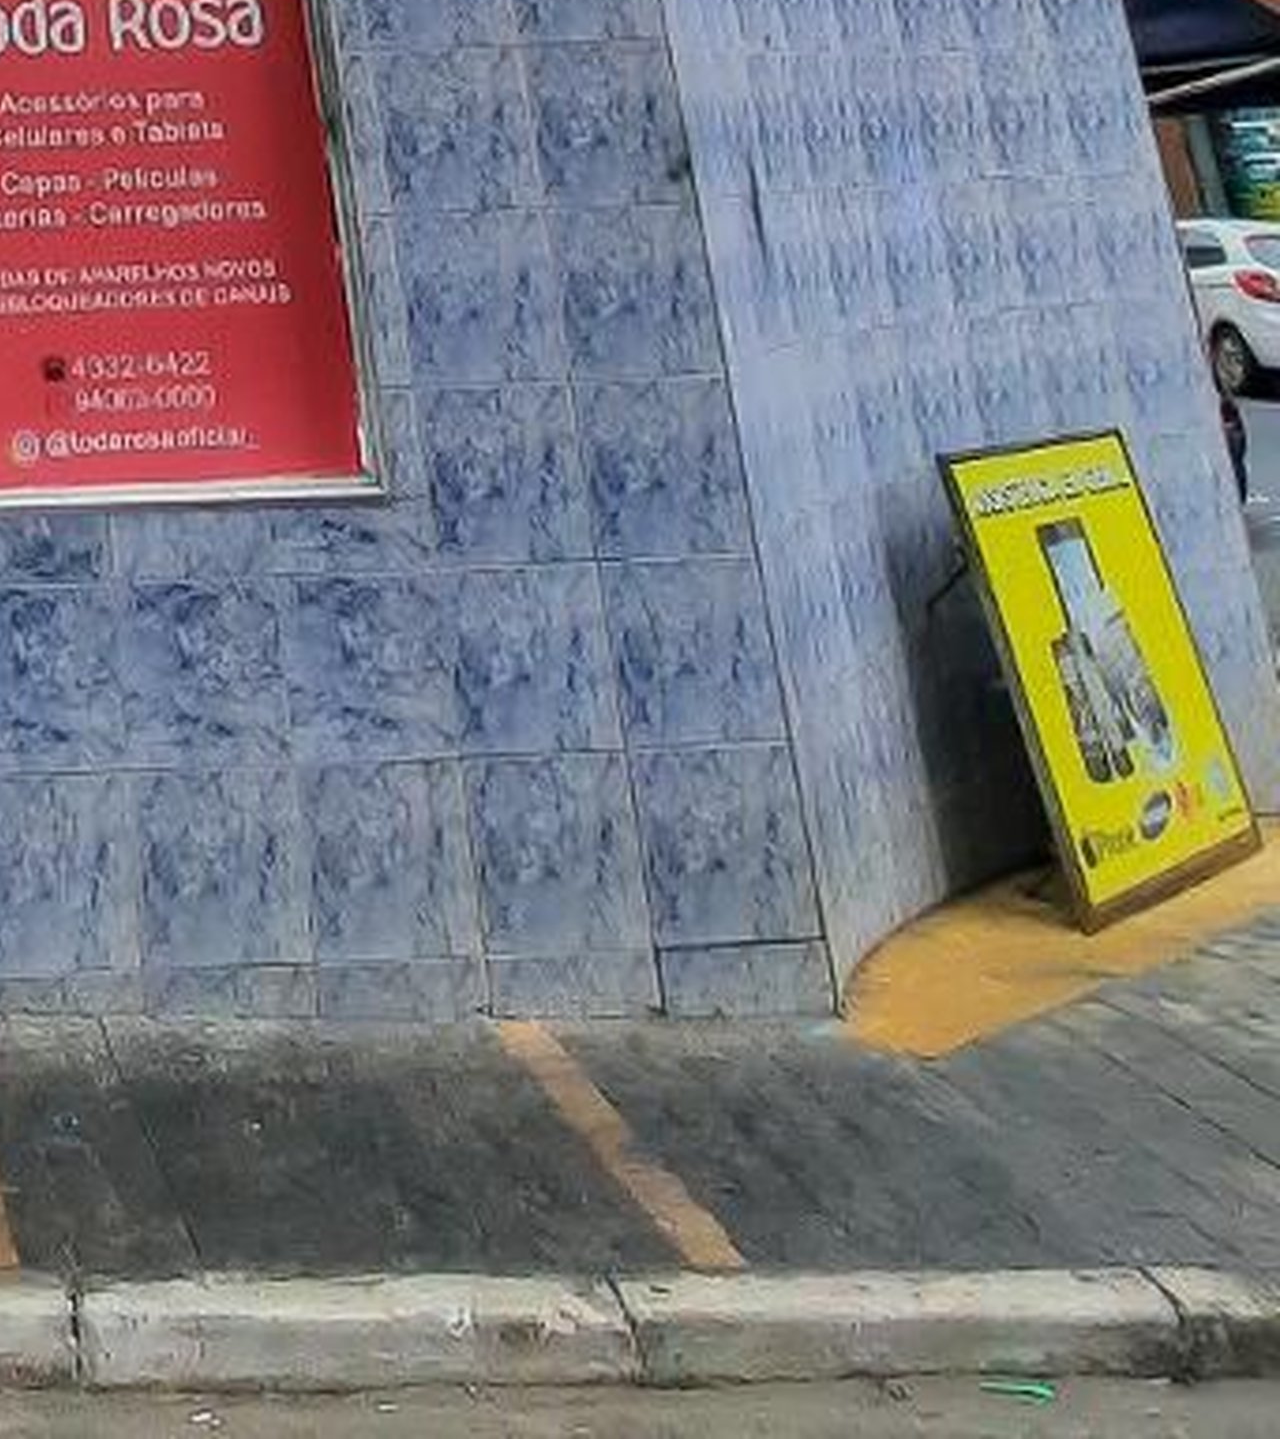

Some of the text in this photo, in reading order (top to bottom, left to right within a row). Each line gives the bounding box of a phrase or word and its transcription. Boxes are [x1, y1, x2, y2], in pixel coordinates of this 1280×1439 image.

[146, 92, 206, 117] para
[134, 120, 224, 143] Tablets
[0, 171, 81, 200] Capas
[88, 197, 267, 228] Carregadores
